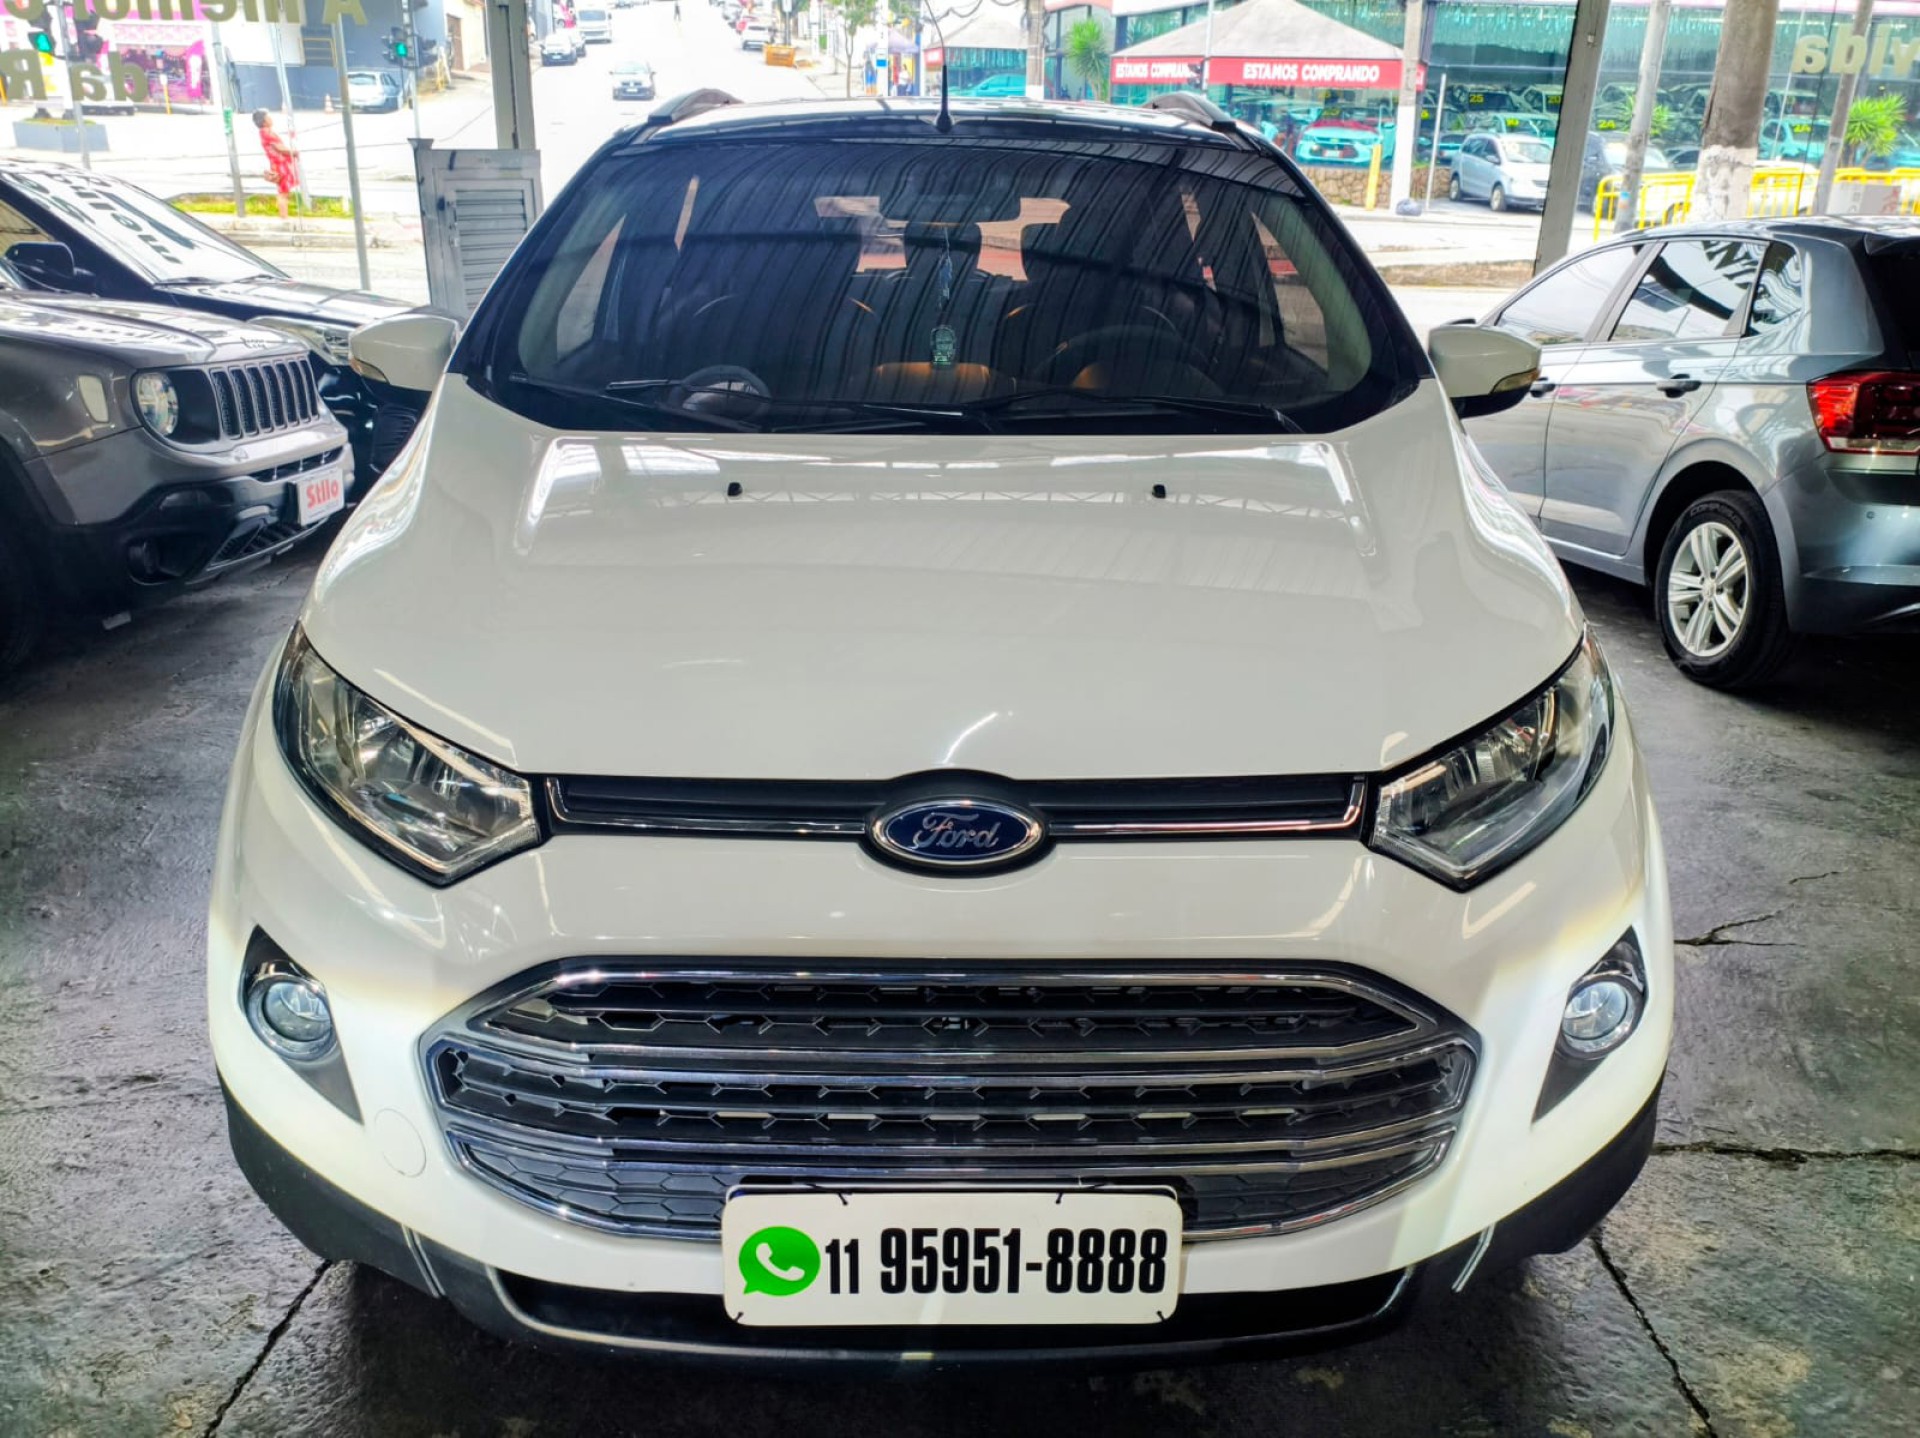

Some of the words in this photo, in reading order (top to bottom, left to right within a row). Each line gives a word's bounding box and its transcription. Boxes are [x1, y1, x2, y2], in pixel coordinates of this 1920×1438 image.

[1243, 63, 1298, 80] ESTAMOS
[1302, 65, 1380, 82] COMPRANDO
[908, 811, 1001, 850] Ford
[825, 1238, 860, 1294] 11
[880, 1227, 1168, 1294] 95951-8888
